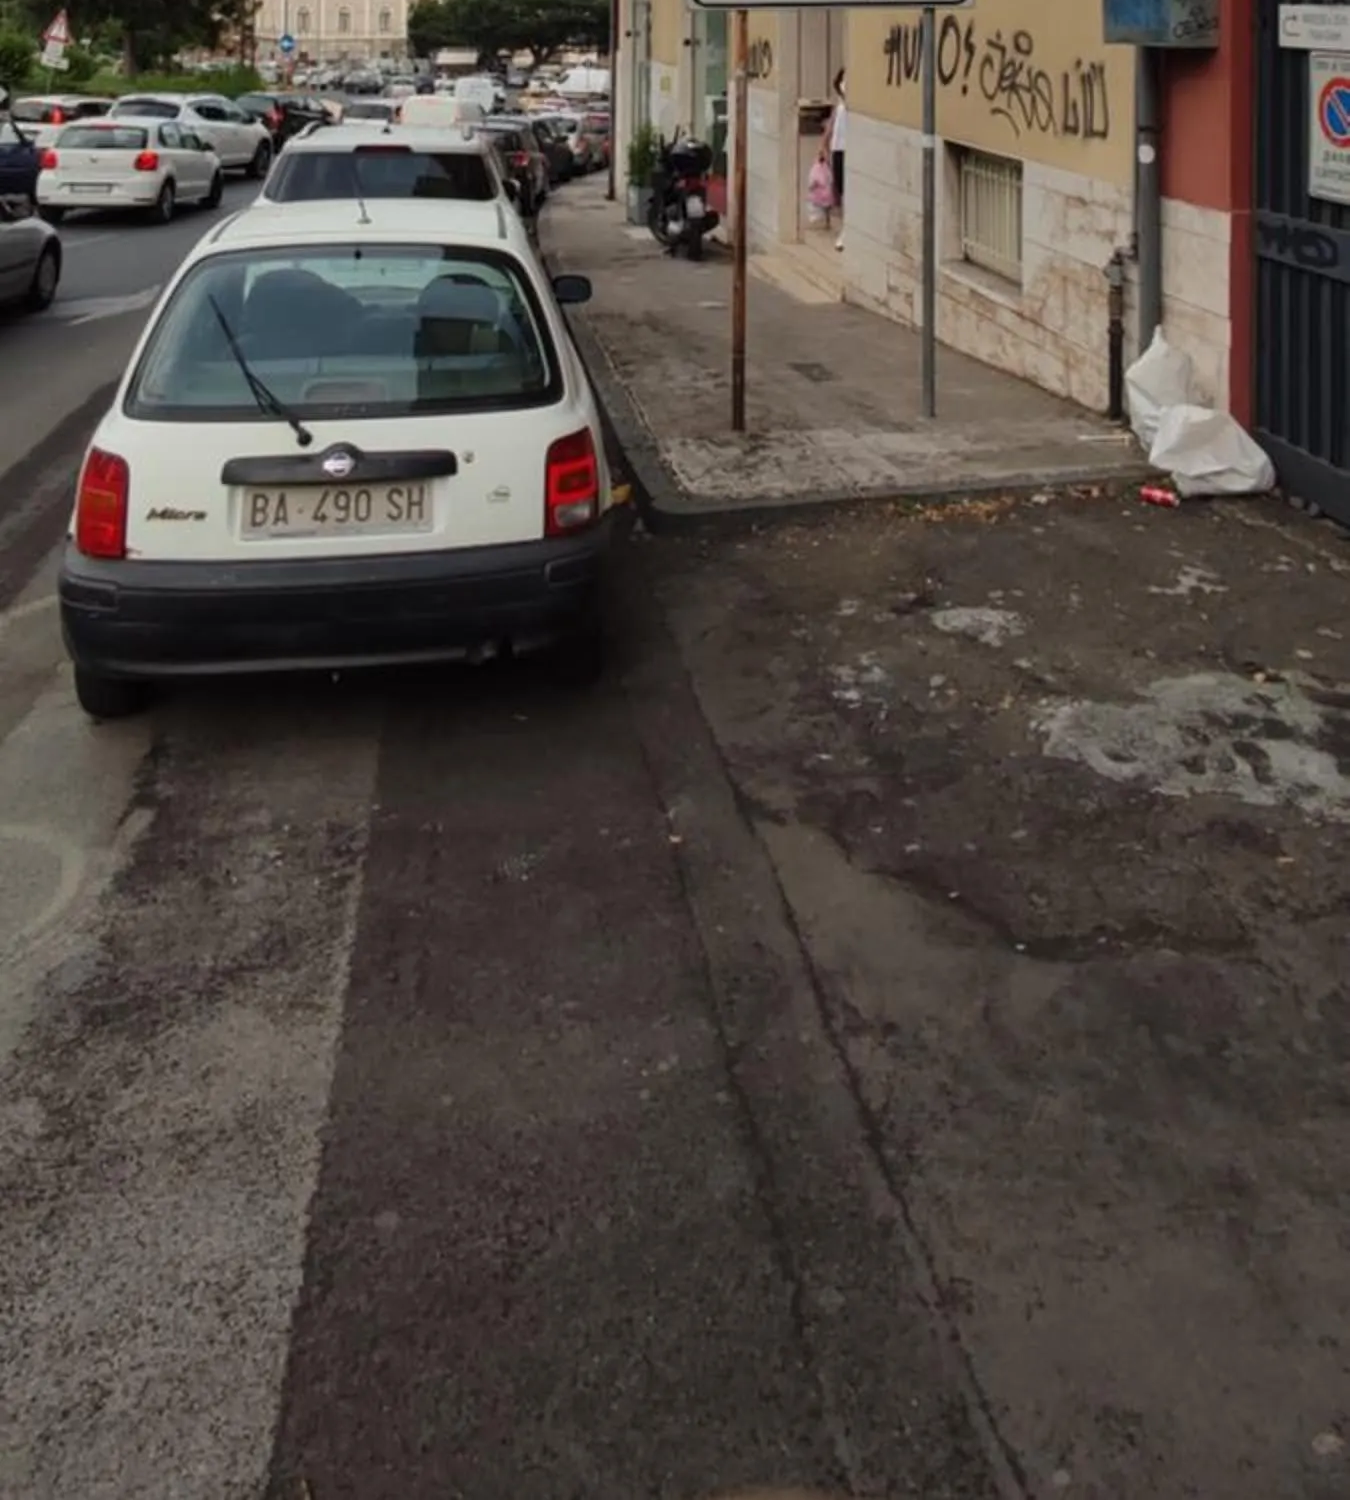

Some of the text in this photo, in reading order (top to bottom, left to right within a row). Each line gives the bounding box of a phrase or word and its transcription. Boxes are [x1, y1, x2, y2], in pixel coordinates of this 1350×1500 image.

[251, 485, 425, 527] BA 490 SH
